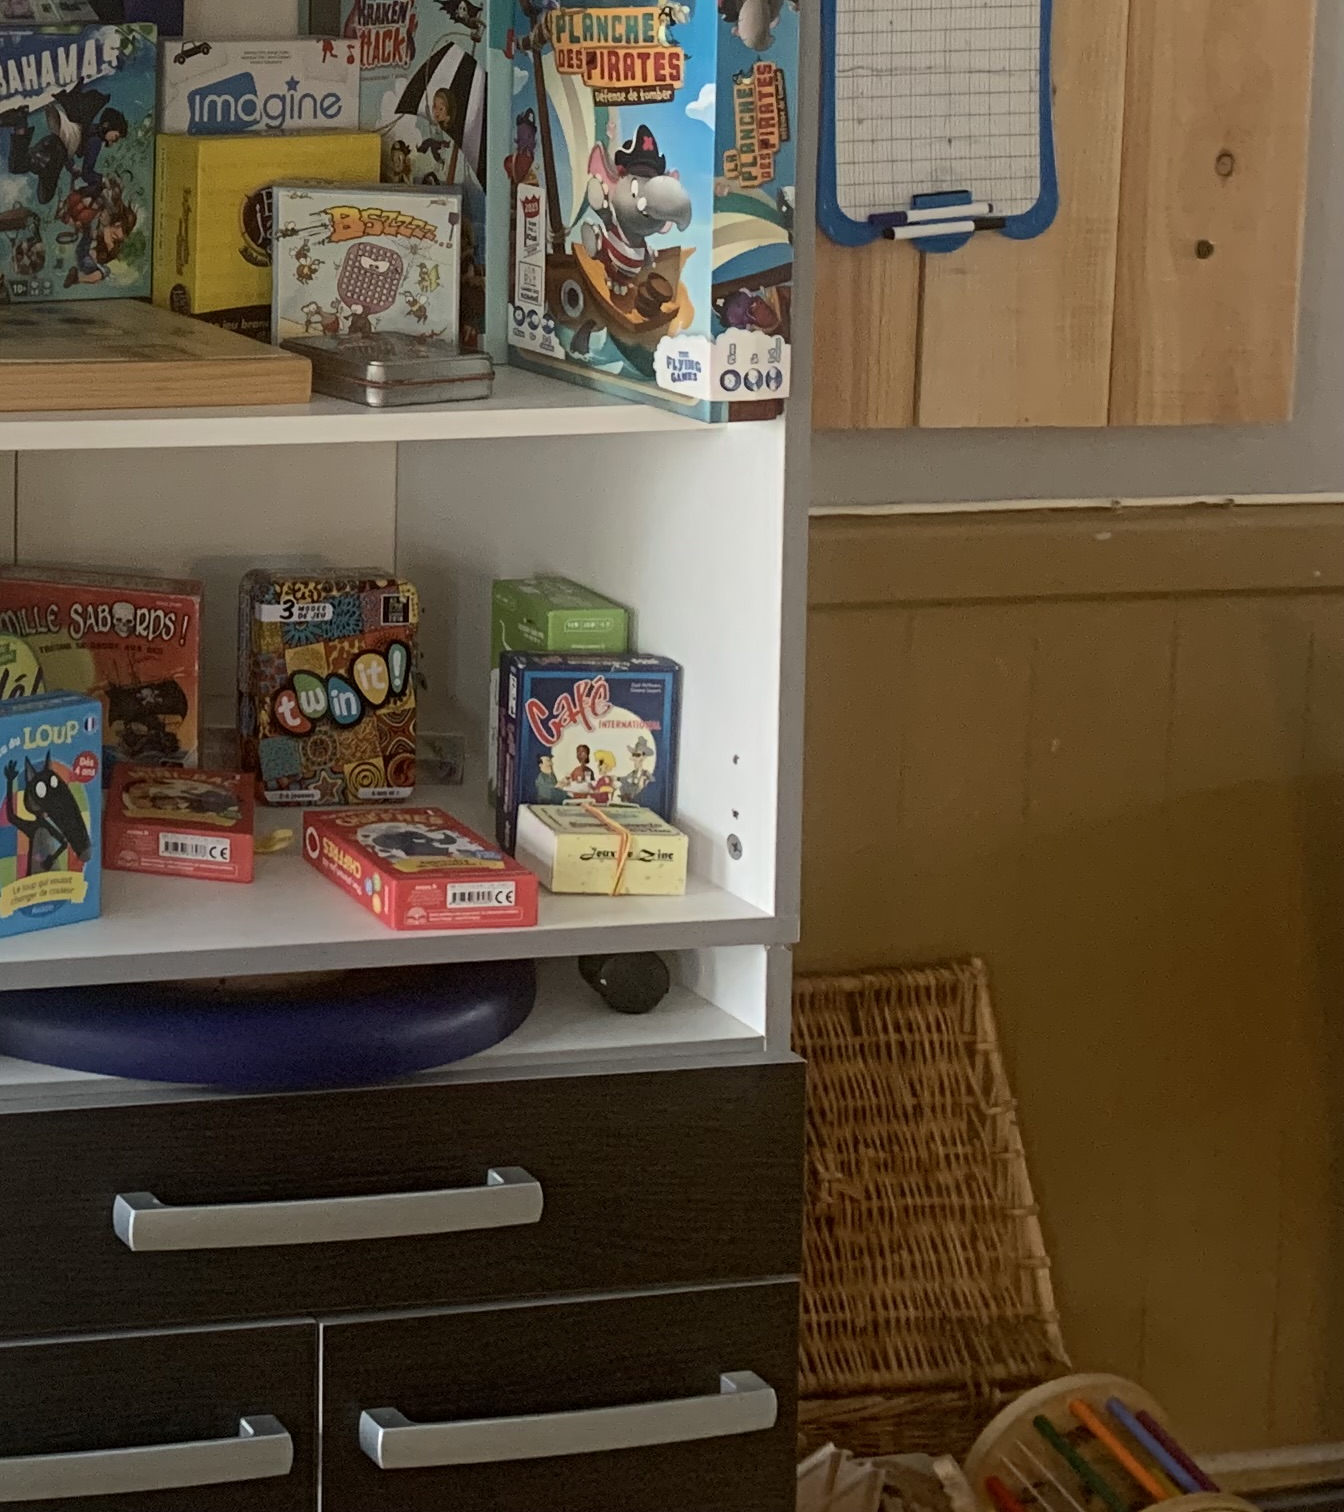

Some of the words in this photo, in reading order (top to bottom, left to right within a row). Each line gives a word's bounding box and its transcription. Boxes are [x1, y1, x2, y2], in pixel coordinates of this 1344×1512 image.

[556, 12, 655, 46] PLANCHE
[559, 50, 583, 71] DES
[586, 51, 682, 84] PIRATES
[195, 76, 342, 129] imagine
[640, 88, 673, 102] tomber
[666, 357, 702, 373] FLYING
[0, 604, 62, 636] MILLE
[279, 599, 296, 619] 3
[276, 684, 358, 726] twin
[525, 675, 611, 746] Café
[9, 736, 22, 750] du
[22, 719, 80, 750] LOUP
[74, 766, 81, 776] 4
[81, 766, 96, 778] ans
